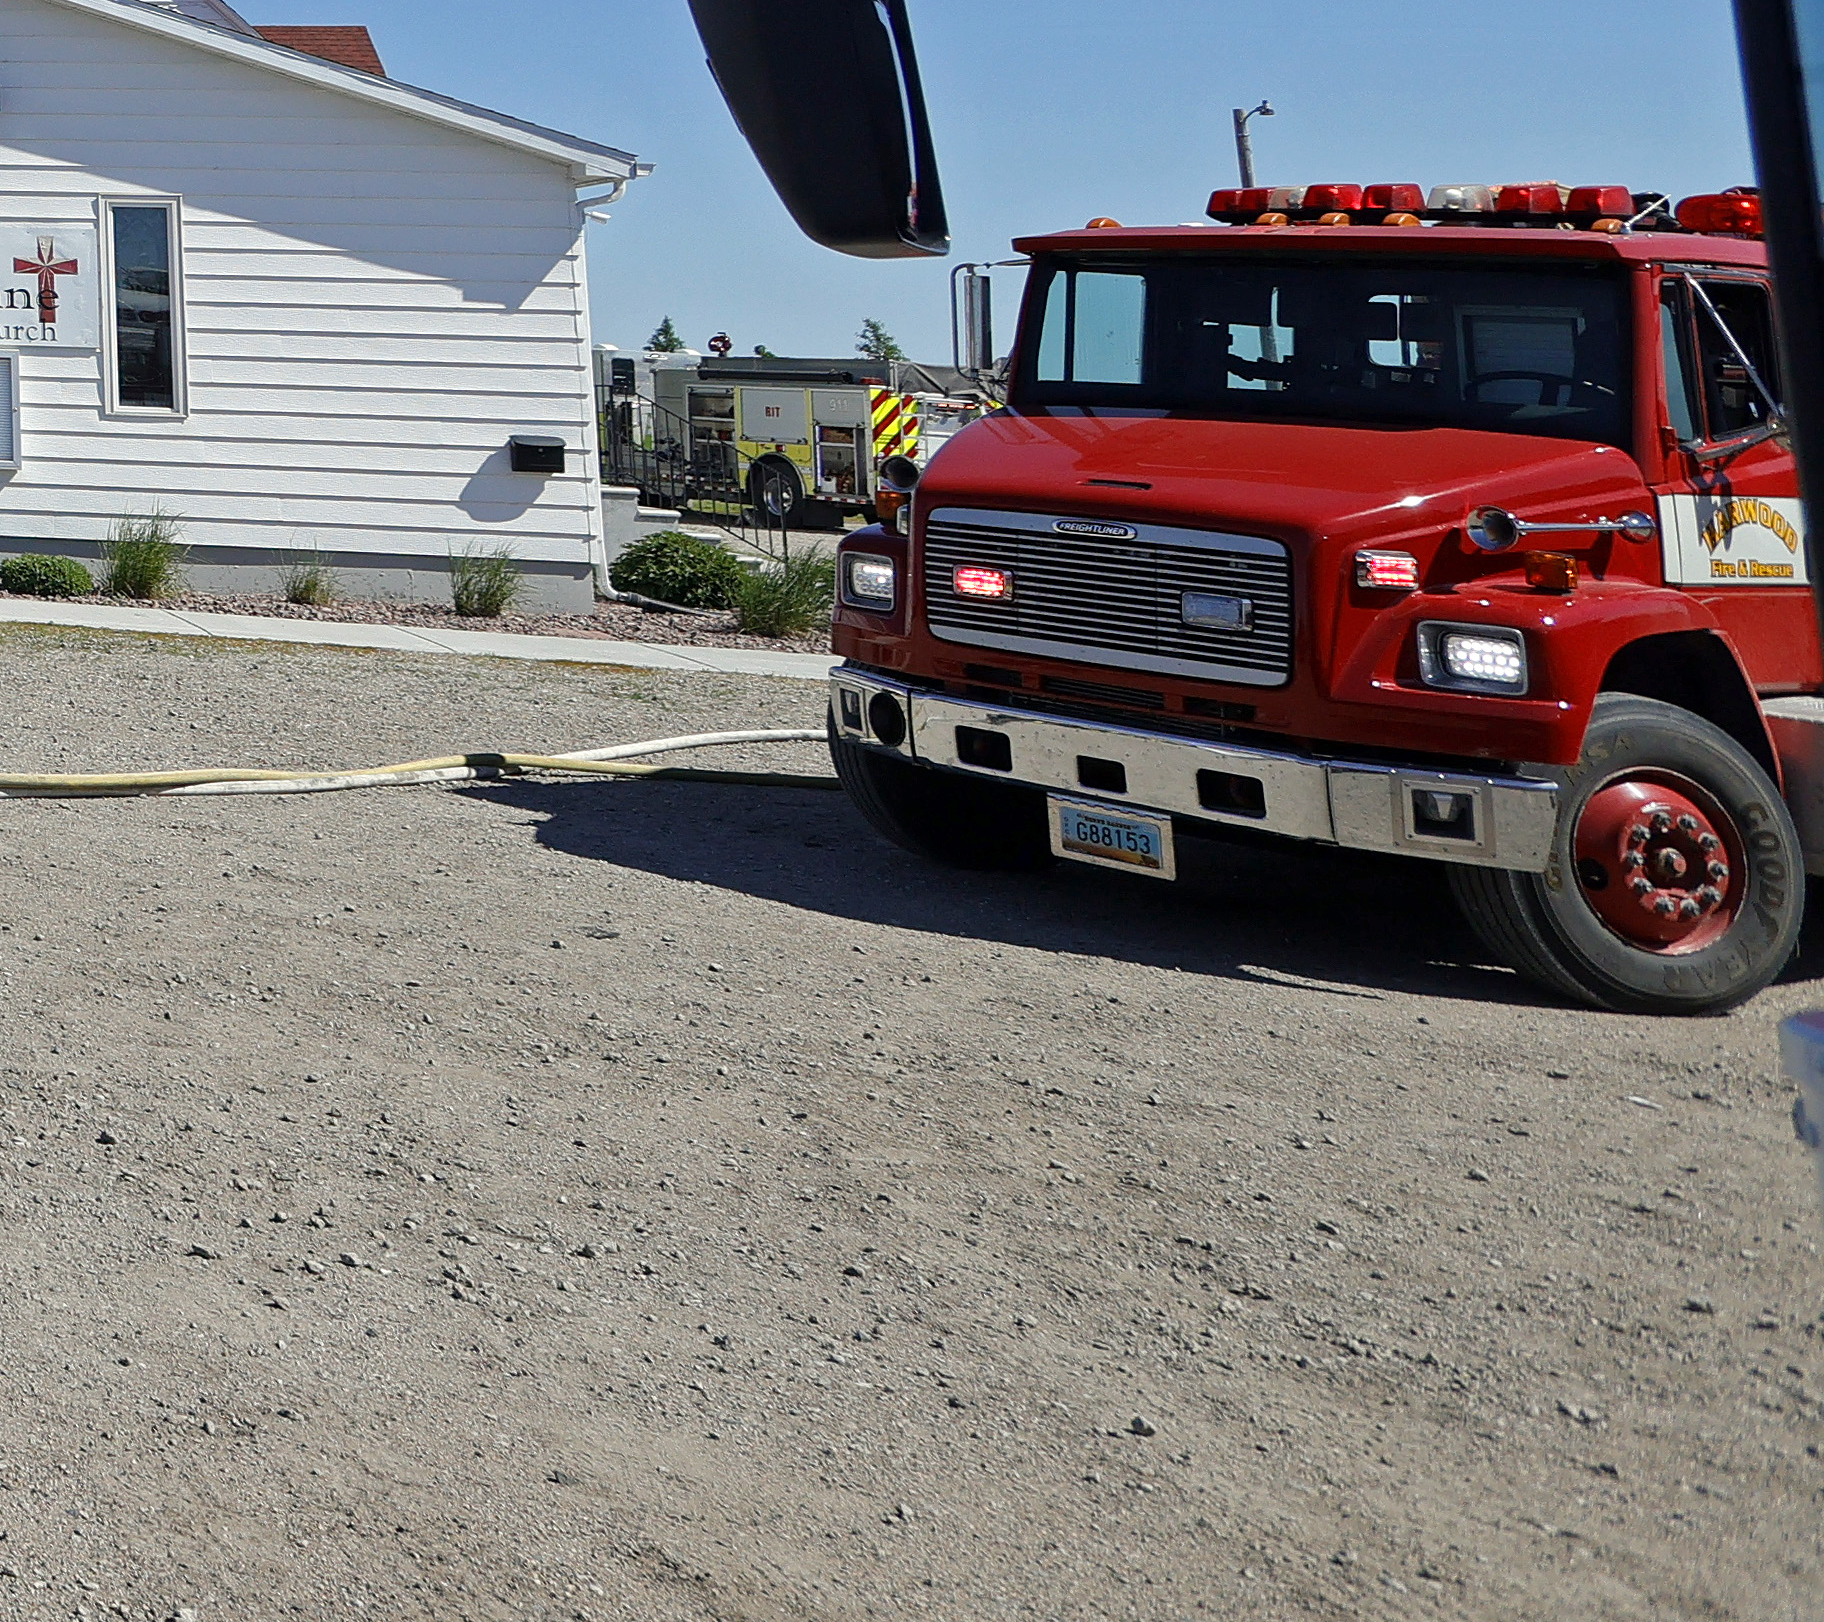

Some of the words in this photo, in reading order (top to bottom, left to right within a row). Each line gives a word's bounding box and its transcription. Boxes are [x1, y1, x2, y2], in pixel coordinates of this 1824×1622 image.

[1058, 522, 1126, 536] FREIGHTLINER
[1702, 498, 1799, 556] HARWOOD
[1710, 559, 1736, 577] Fire
[1737, 559, 1748, 577] &
[1749, 559, 1794, 578] Rescue
[1076, 821, 1151, 855] G88153
